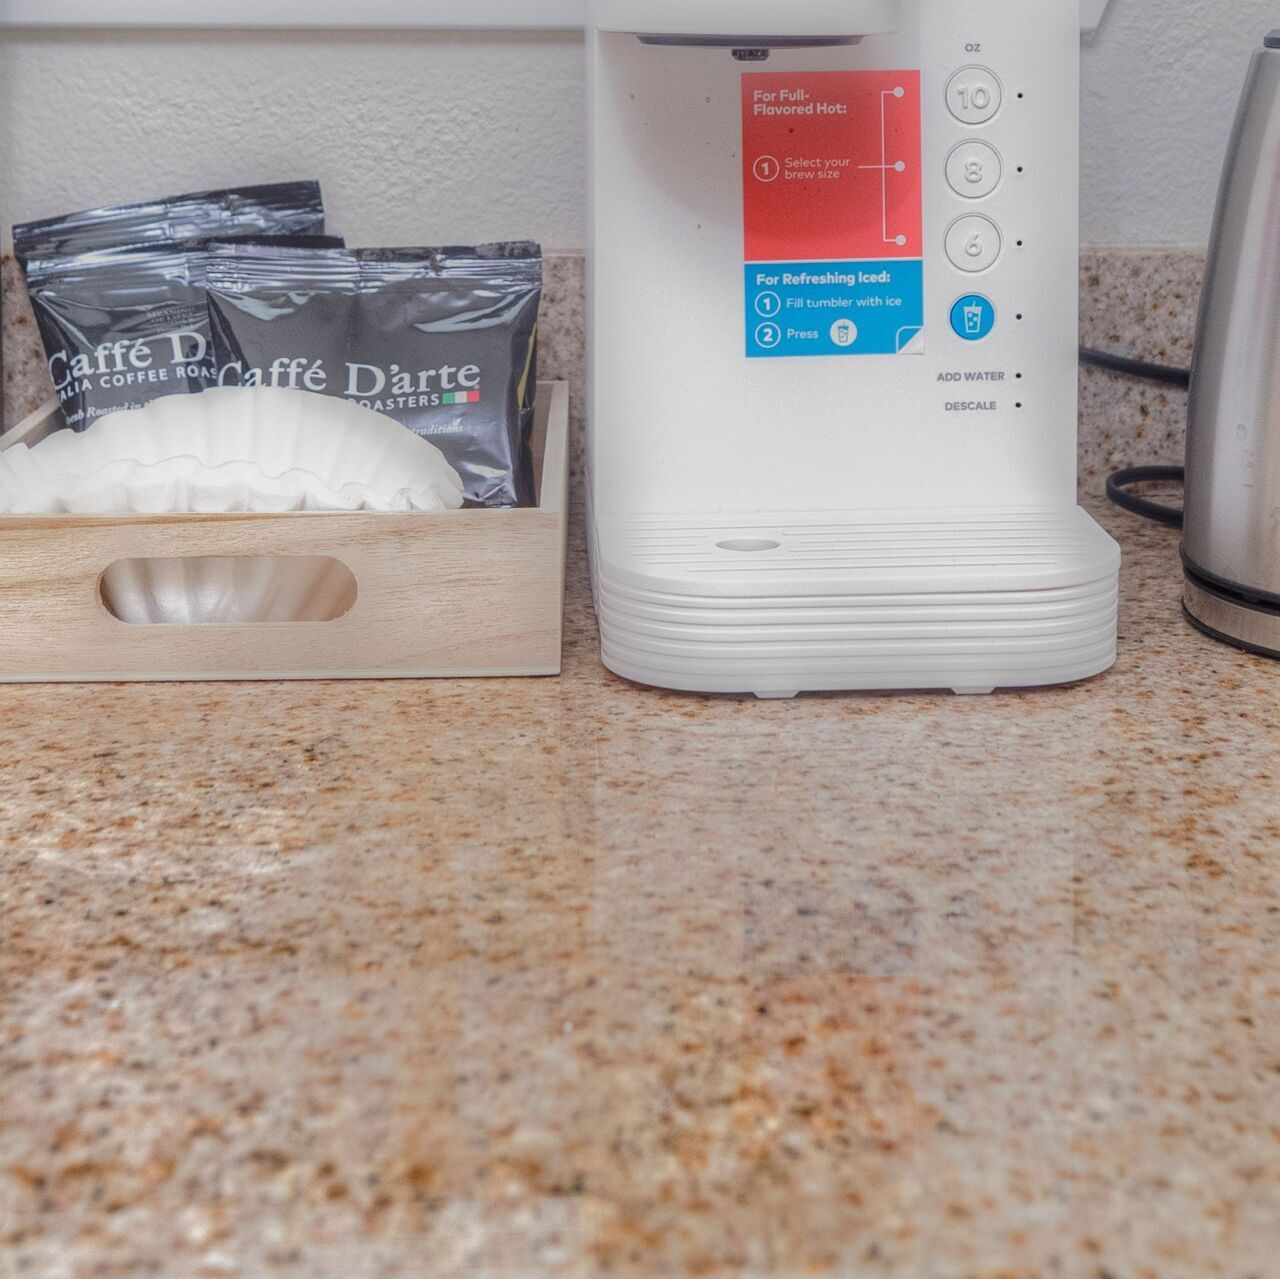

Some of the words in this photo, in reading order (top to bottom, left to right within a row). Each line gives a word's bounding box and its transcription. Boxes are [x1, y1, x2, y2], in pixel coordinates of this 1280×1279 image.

[964, 43, 981, 52] OZ
[753, 90, 776, 102] For
[780, 89, 810, 101] Full-
[957, 86, 991, 110] 10
[753, 103, 813, 116] Flavored
[816, 103, 847, 114] Hot:
[784, 157, 821, 168] Select
[824, 159, 851, 171] your
[784, 169, 815, 180] brew
[817, 169, 840, 179] size
[965, 160, 983, 184] 8
[965, 233, 983, 257] 6
[756, 273, 779, 286] For
[782, 272, 856, 287] Refreshing
[858, 270, 891, 283] Iced:
[786, 297, 804, 308] Fill
[807, 297, 853, 308] tumbler
[856, 296, 882, 307] with
[885, 295, 902, 306] ice
[786, 328, 819, 339] Press
[48, 337, 153, 390] Caffé
[100, 368, 169, 388] COFFEE
[176, 366, 218, 380] ROAS
[217, 357, 327, 391] Caffé
[344, 361, 481, 397] D'arte
[936, 372, 962, 382] ADD
[964, 371, 1005, 381] WATER
[944, 401, 997, 411] DESCALE
